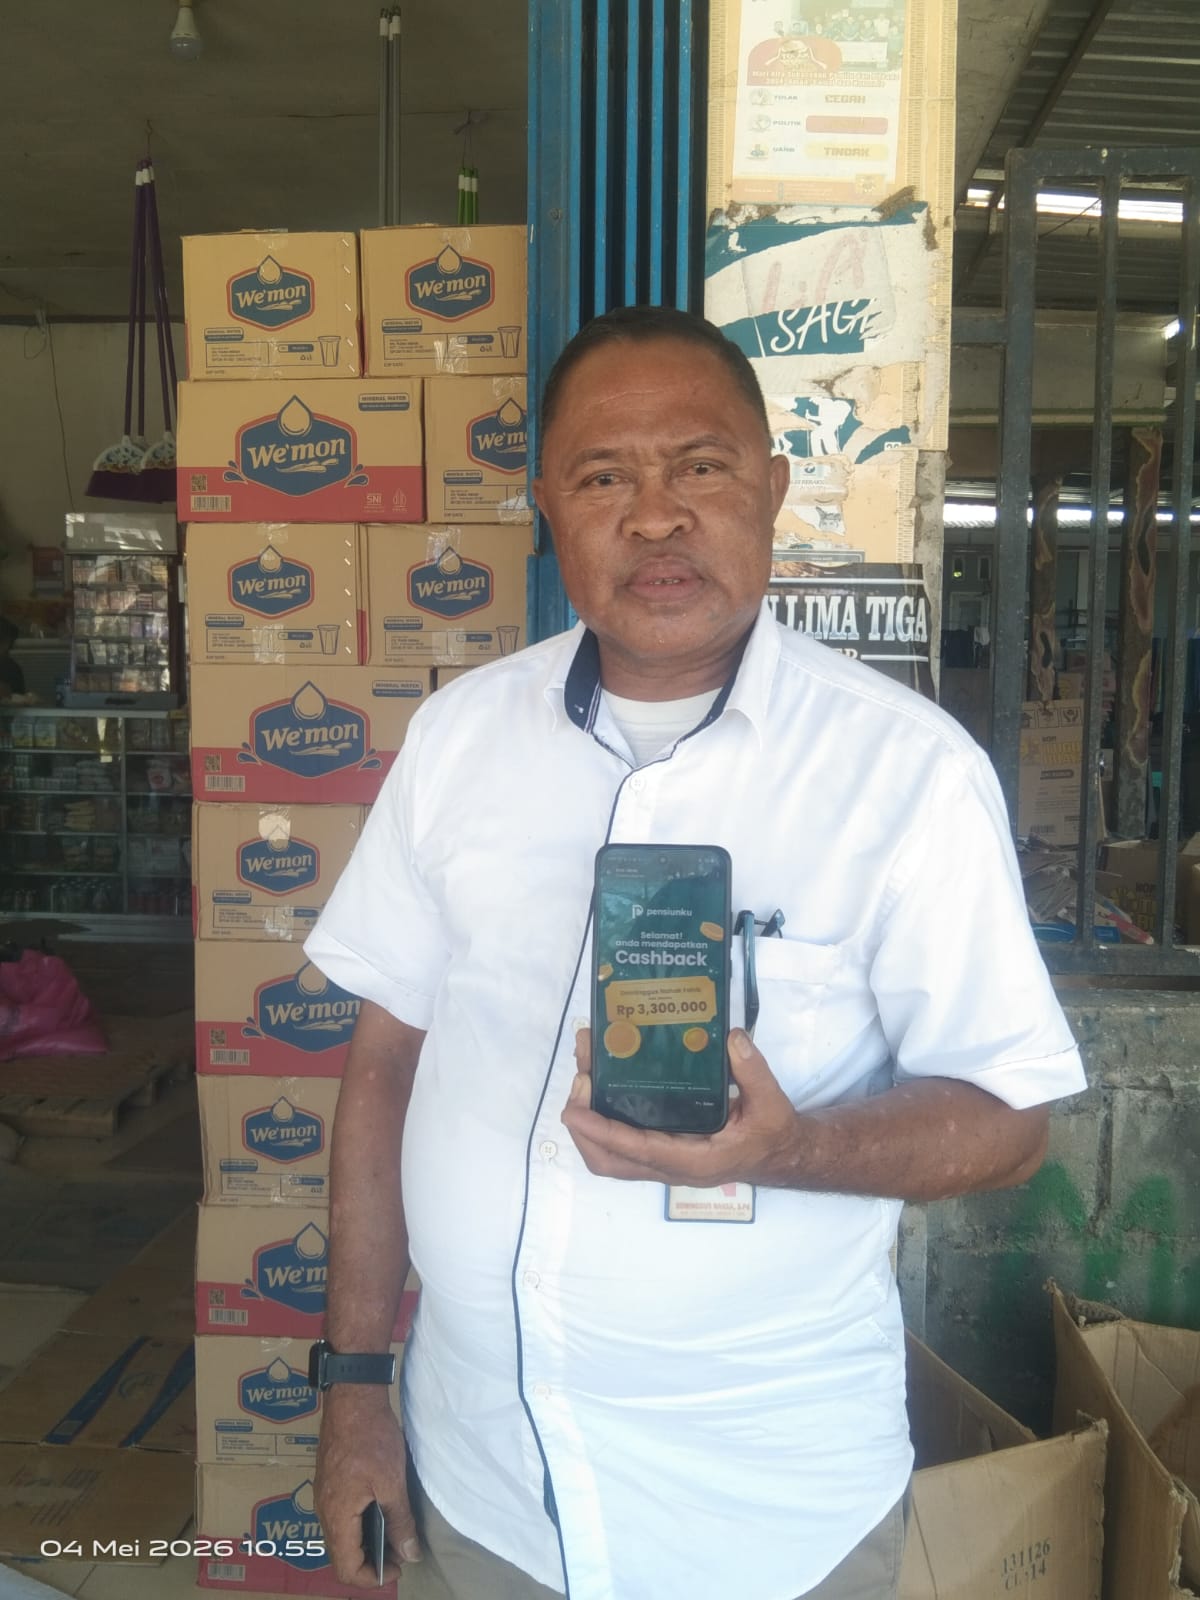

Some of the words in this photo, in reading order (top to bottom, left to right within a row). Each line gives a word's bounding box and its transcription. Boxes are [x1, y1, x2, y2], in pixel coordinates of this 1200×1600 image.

[235, 284, 307, 309] We'mon
[414, 273, 487, 299] We'mon
[475, 431, 527, 452] We'm
[246, 437, 346, 470] We'mon
[237, 573, 307, 597] We'mon
[416, 574, 486, 598] We'mon
[785, 595, 860, 641] LIMA
[865, 595, 928, 643] TIGA
[261, 721, 359, 752] We'mon
[245, 852, 313, 874] We'mon
[646, 907, 693, 918] pensiunku
[615, 939, 640, 948] anda
[641, 940, 708, 950] mendapatkan
[615, 950, 708, 967] Cashback
[265, 999, 361, 1026] We'mon
[616, 1005, 635, 1018] Rp
[637, 1001, 708, 1015] 3,300,000
[250, 1124, 318, 1144] We'mon
[264, 1265, 328, 1289] We'm
[246, 1385, 313, 1404] We'mon
[261, 1519, 324, 1542] We'm
